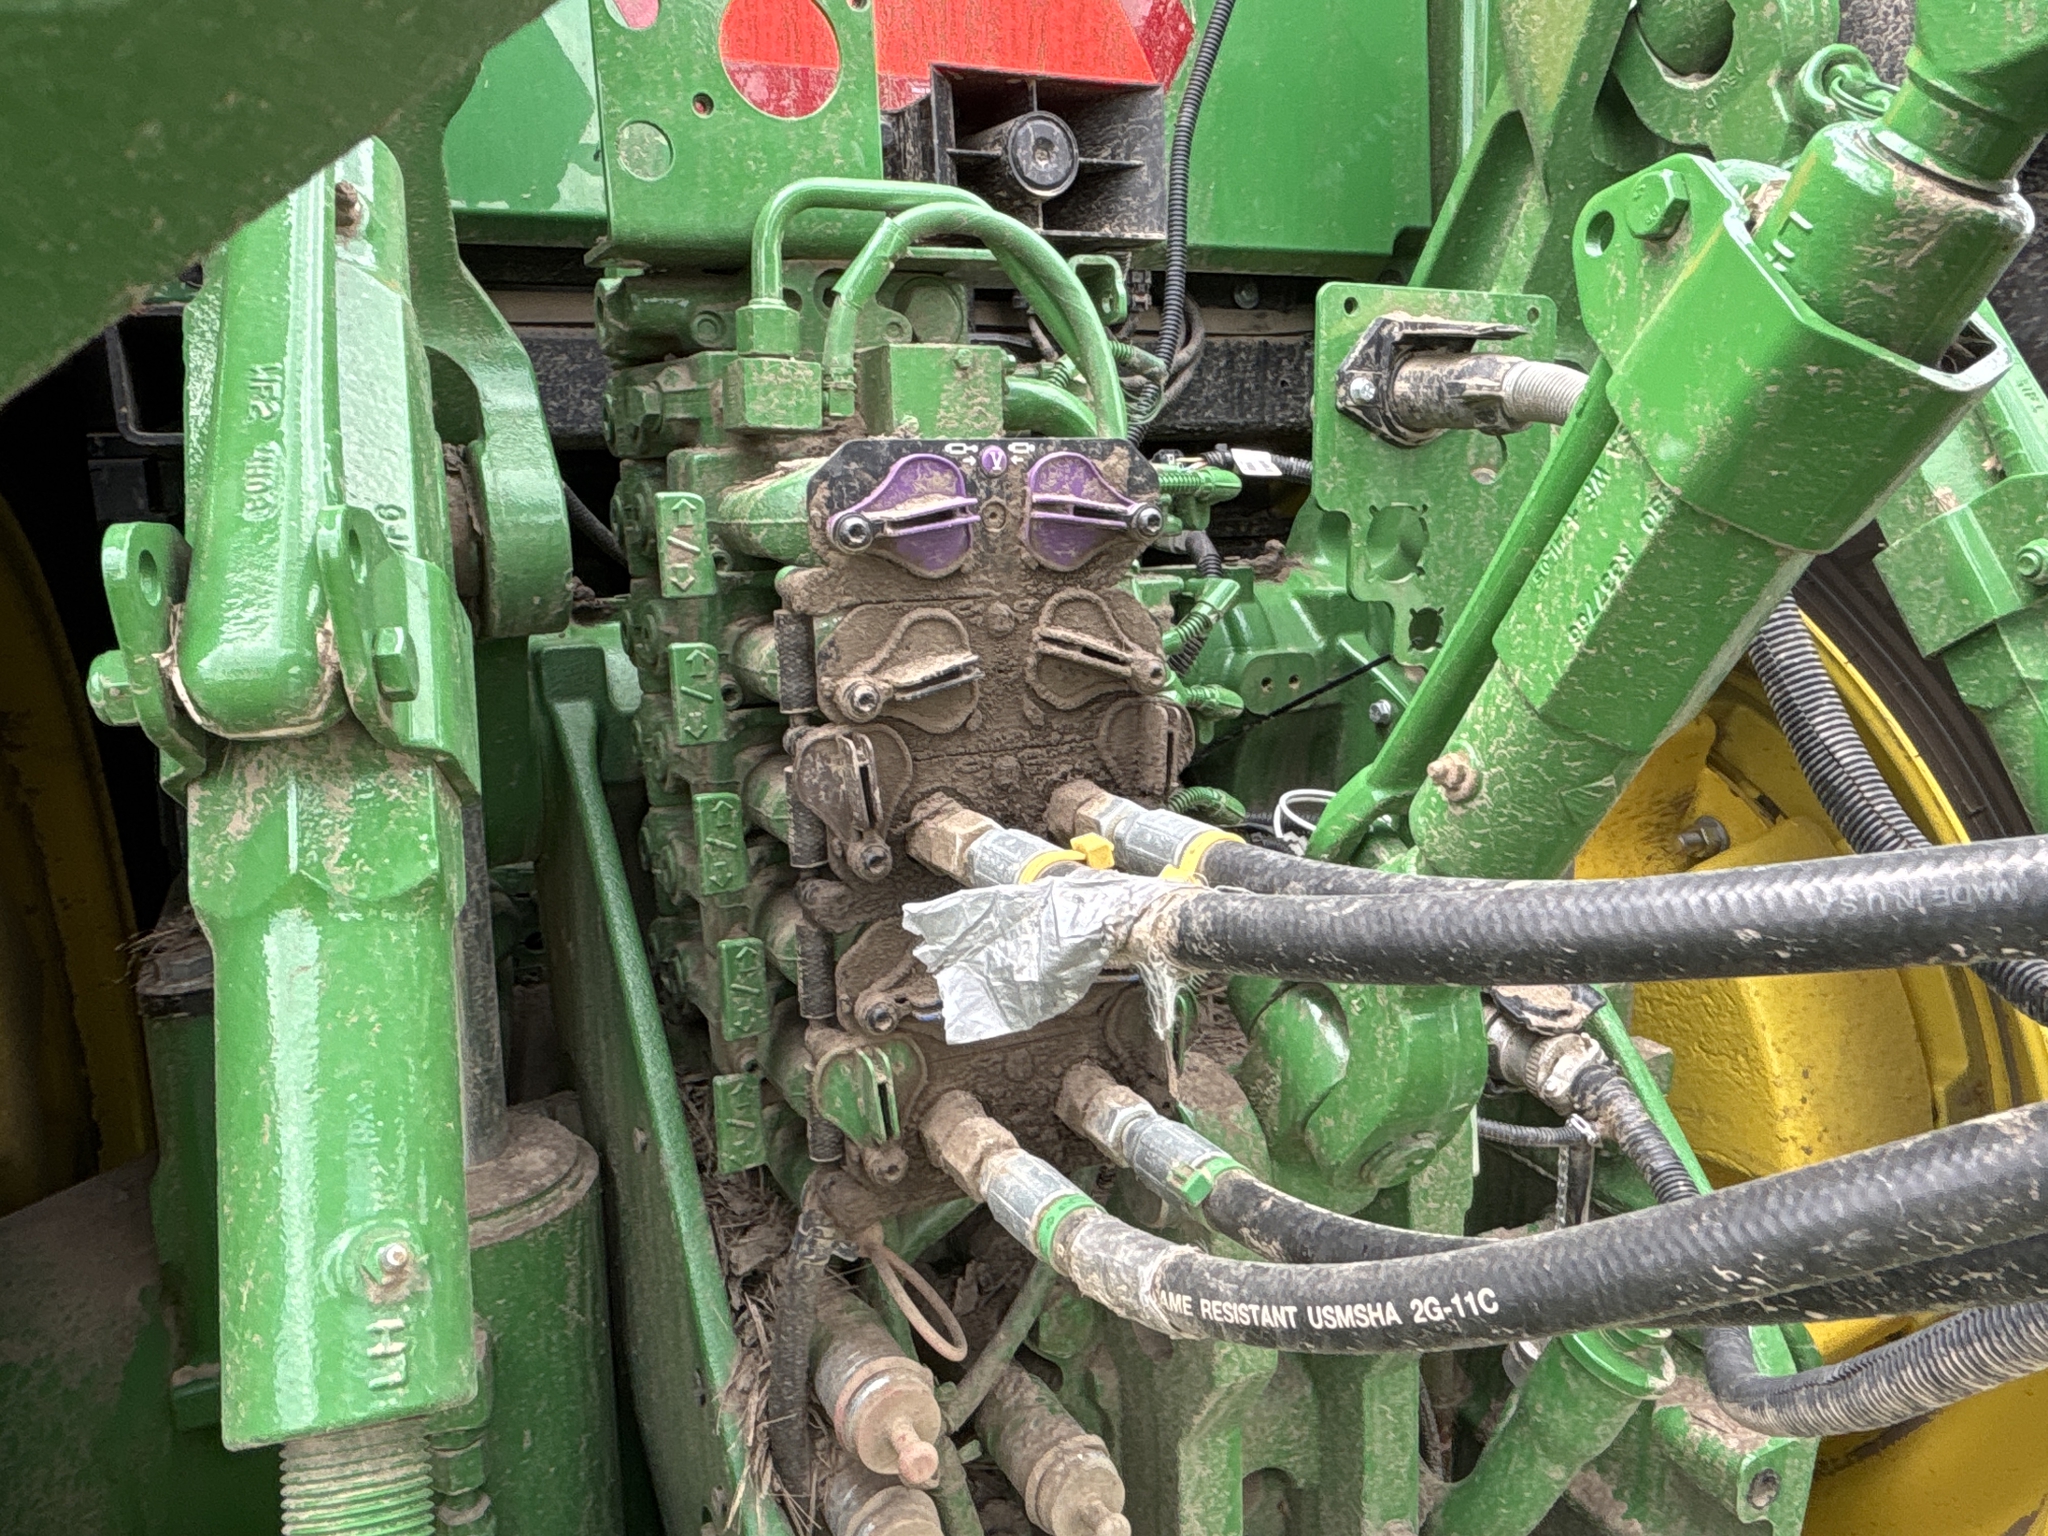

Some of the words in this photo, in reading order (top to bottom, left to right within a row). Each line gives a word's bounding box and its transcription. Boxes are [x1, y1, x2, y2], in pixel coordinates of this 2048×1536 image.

[1891, 886, 1922, 910] IN
[1930, 879, 2018, 908] MADE
[1200, 1298, 1298, 1330] RESISTANT
[1306, 1301, 1403, 1330] USMSHA
[1409, 1286, 1500, 1324] 2G-11C
